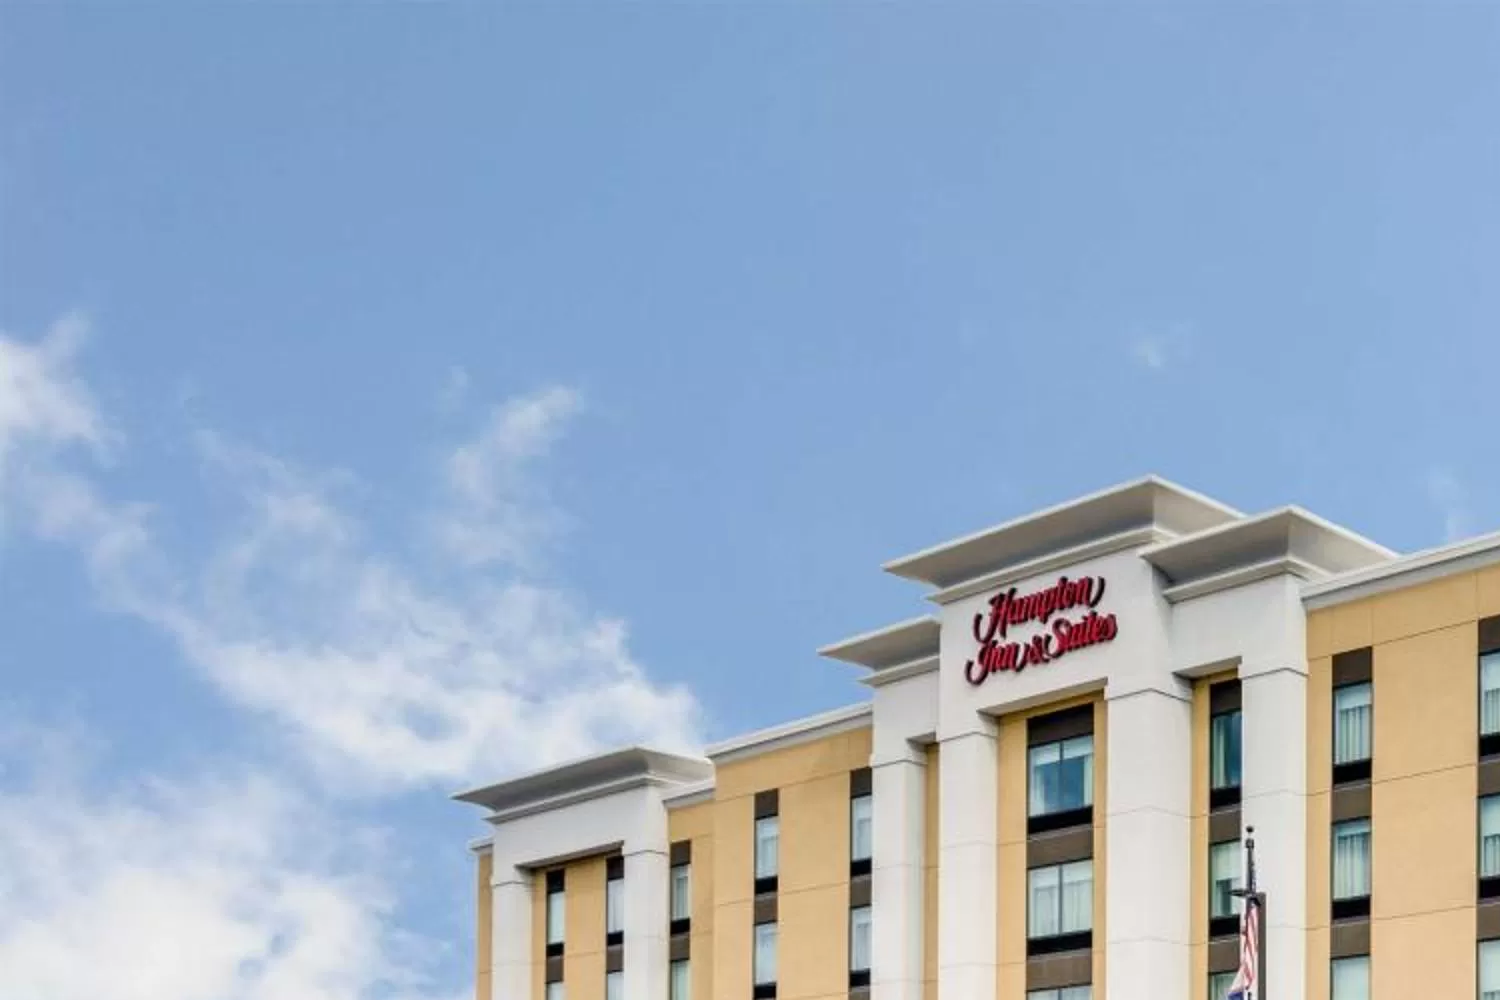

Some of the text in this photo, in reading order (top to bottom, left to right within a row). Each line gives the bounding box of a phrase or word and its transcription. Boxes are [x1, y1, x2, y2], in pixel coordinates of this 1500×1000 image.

[973, 576, 1105, 643] Hampton
[965, 611, 1118, 685] Inn & Suites
